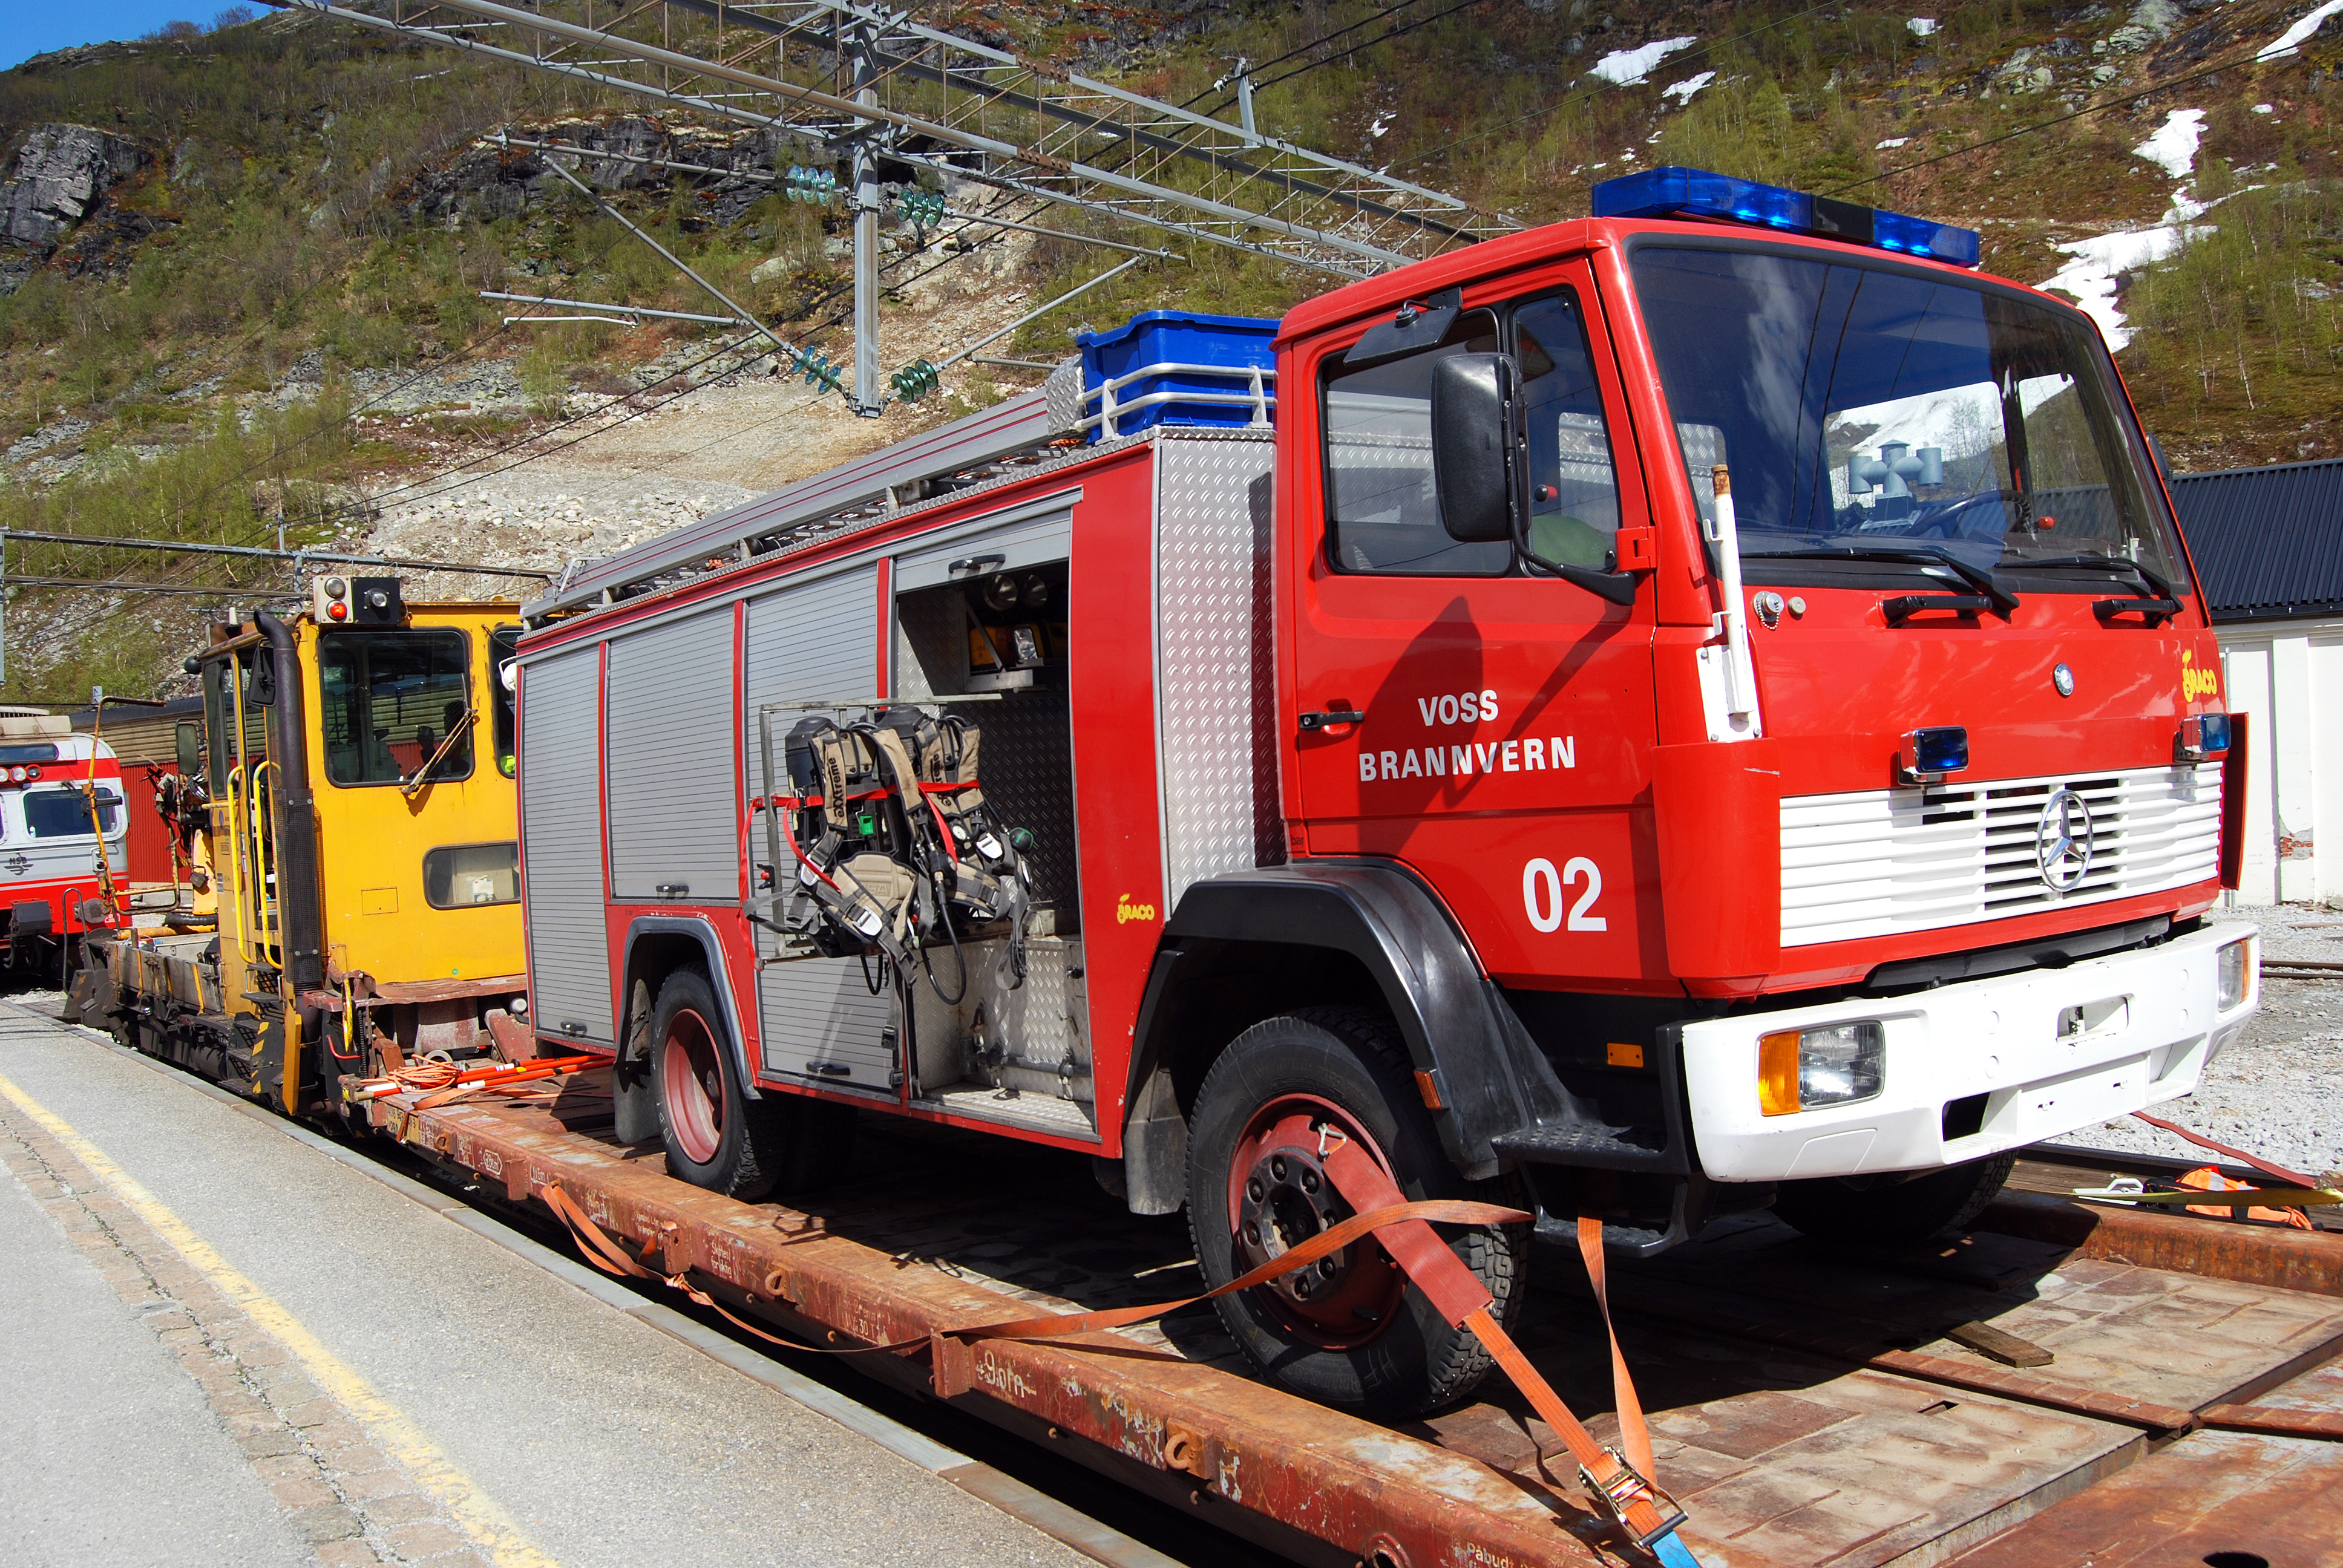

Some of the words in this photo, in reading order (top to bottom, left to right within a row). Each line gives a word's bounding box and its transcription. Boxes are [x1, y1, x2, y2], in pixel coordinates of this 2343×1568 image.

[1418, 690, 1499, 726] VOSS
[1359, 736, 1575, 782] BRANNVERN
[9, 857, 27, 865] NSB
[1522, 857, 1607, 933] 02
